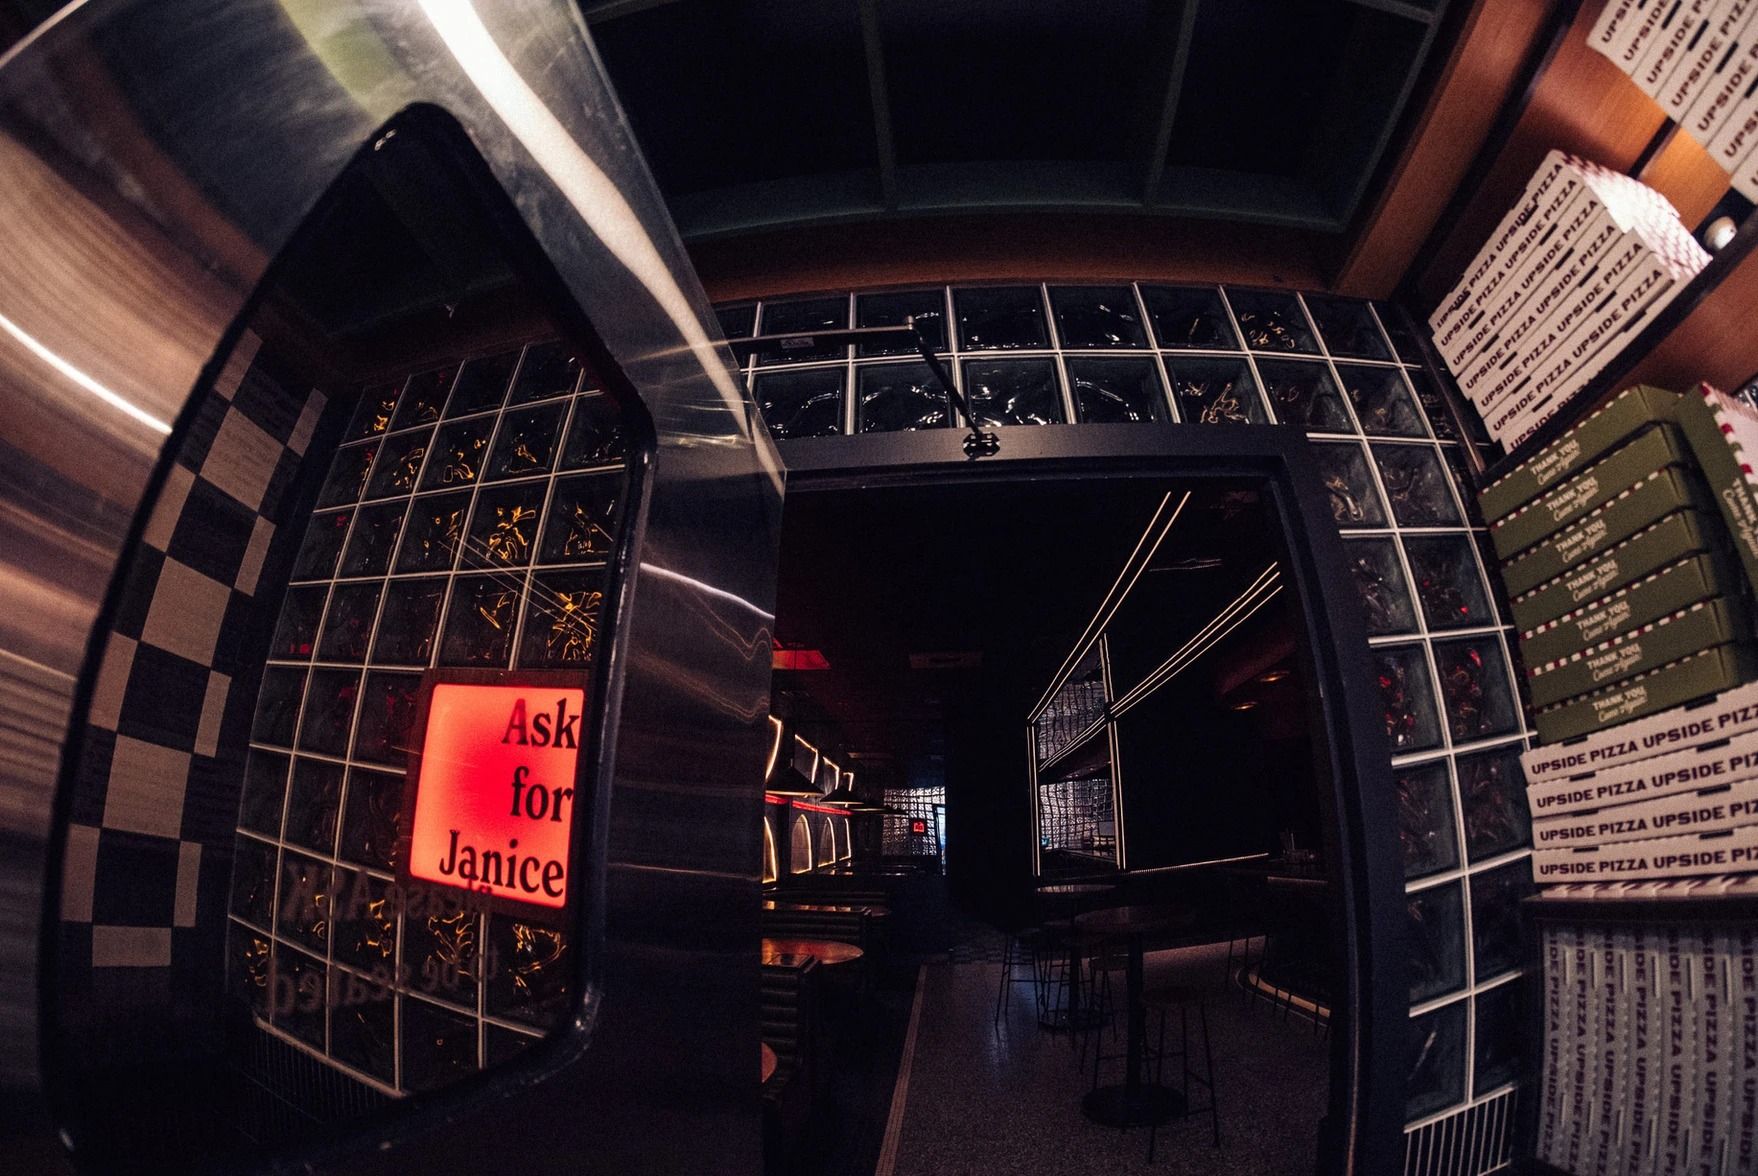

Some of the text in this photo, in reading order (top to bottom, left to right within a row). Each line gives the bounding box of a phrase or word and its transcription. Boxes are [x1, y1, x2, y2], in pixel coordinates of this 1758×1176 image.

[1601, 0, 1634, 43] UPSI
[1646, 14, 1695, 84] UPSIDE
[1671, 0, 1750, 107] UPSIDE PIZ
[1697, 59, 1752, 131] UPSIDE
[1469, 254, 1497, 288] PIZZA
[1496, 202, 1534, 252] UPSIDE
[1532, 163, 1563, 204] PIZZA
[1441, 179, 1577, 346] UPSIDE PIZZA UPSIDE PIZZA
[1453, 200, 1598, 366] UPSIDE PIZZA UPSIDE PIZZA
[1466, 224, 1615, 389] UPSIDE PIZZA UPSIDE PIZZA
[1481, 242, 1643, 407] UPSIDE PIZZA UPSIDE PIZZA
[1493, 390, 1536, 431] UPSIDE
[1535, 358, 1572, 394] PIZZA
[1572, 308, 1622, 359] UPSIDE
[1621, 269, 1663, 311] PIZZA
[1530, 452, 1559, 475] THANK
[1546, 489, 1576, 511] THANK
[1555, 531, 1585, 552] THANK
[1566, 570, 1597, 591] THANK
[1576, 610, 1607, 630] THANK
[1586, 651, 1618, 670] THANK
[501, 698, 582, 750] Ask
[1592, 692, 1623, 711] THANK
[1531, 753, 1587, 775] UPSIDE
[1590, 741, 1639, 762] PIZZA
[1643, 717, 1715, 749] UPSIDE
[509, 766, 574, 822] for
[1536, 789, 1594, 808] UPSIDE
[1597, 779, 1647, 798] PIZZA
[1652, 761, 1726, 788] UPSIDE
[1540, 828, 1596, 841] UPSIDE
[1598, 819, 1648, 836] PIZZA
[1652, 802, 1726, 829] UPSIDE
[439, 830, 565, 898] Janice
[1540, 863, 1596, 876] UPSIDE
[1599, 858, 1648, 872] PIZZA
[1653, 850, 1727, 870] UPSIDE
[1550, 976, 1559, 1031] PIZZA
[1577, 979, 1586, 1037] PIZZA
[1605, 983, 1615, 1043] PIZZA
[1636, 987, 1647, 1049] PIZZA
[1671, 991, 1682, 1056] PIZZA
[1705, 994, 1717, 1063] PIZZA
[1744, 997, 1757, 1070] PIZZA
[1573, 1044, 1585, 1115] UPSIDE
[1601, 1050, 1614, 1125] UPSIDE
[1632, 1057, 1646, 1137] UPSIDE
[1667, 1064, 1682, 1148] UPSIDE
[1700, 1071, 1716, 1159] UPSIDE
[1740, 1078, 1756, 1170] UPSIDE
[1597, 1130, 1610, 1174] PIZZ
